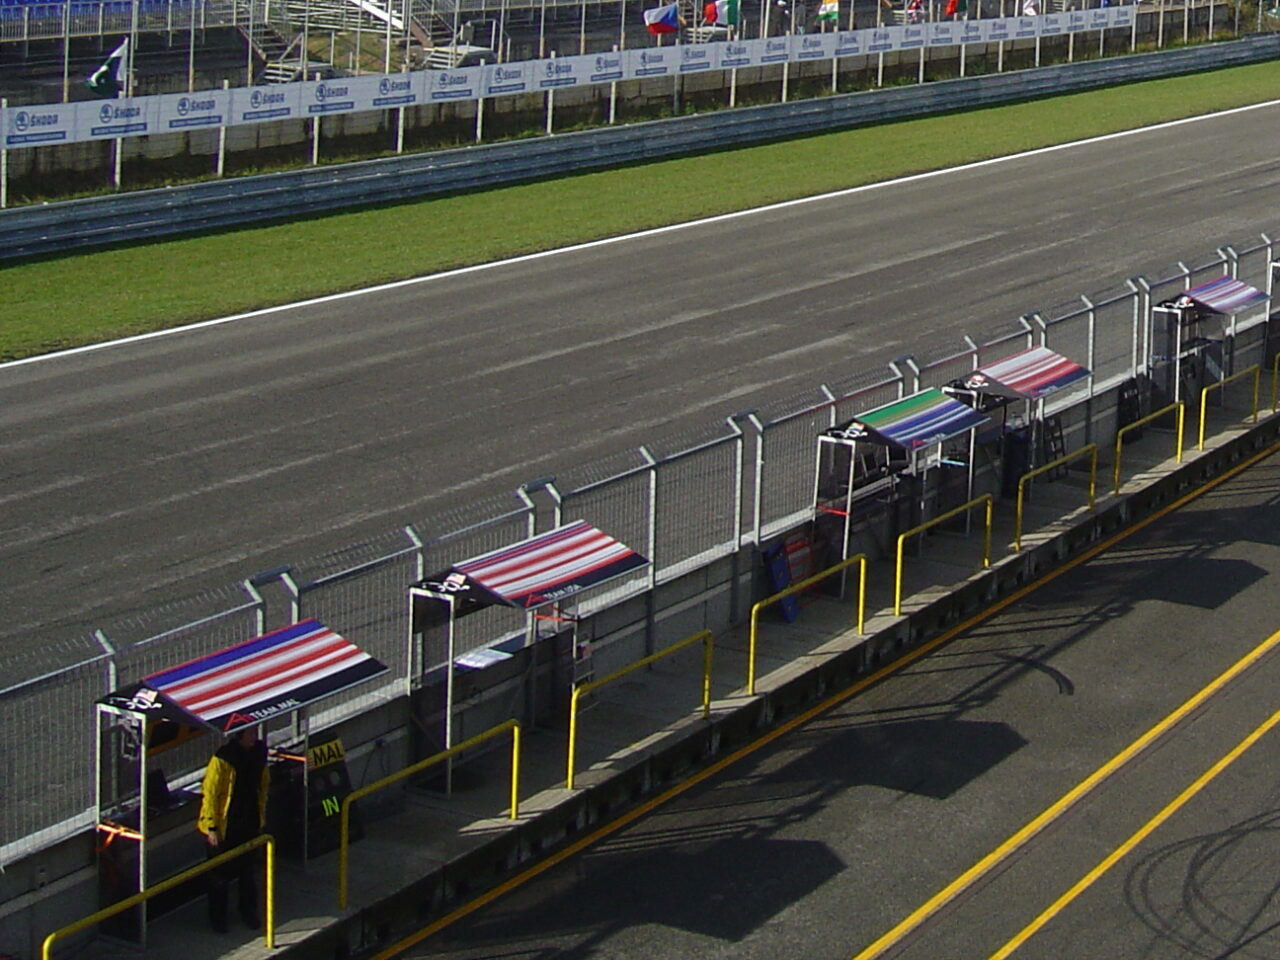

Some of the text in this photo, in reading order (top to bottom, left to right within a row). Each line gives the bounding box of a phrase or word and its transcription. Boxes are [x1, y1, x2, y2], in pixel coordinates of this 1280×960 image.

[250, 705, 279, 720] TEAM
[312, 742, 343, 767] MAL
[322, 795, 340, 817] IN
